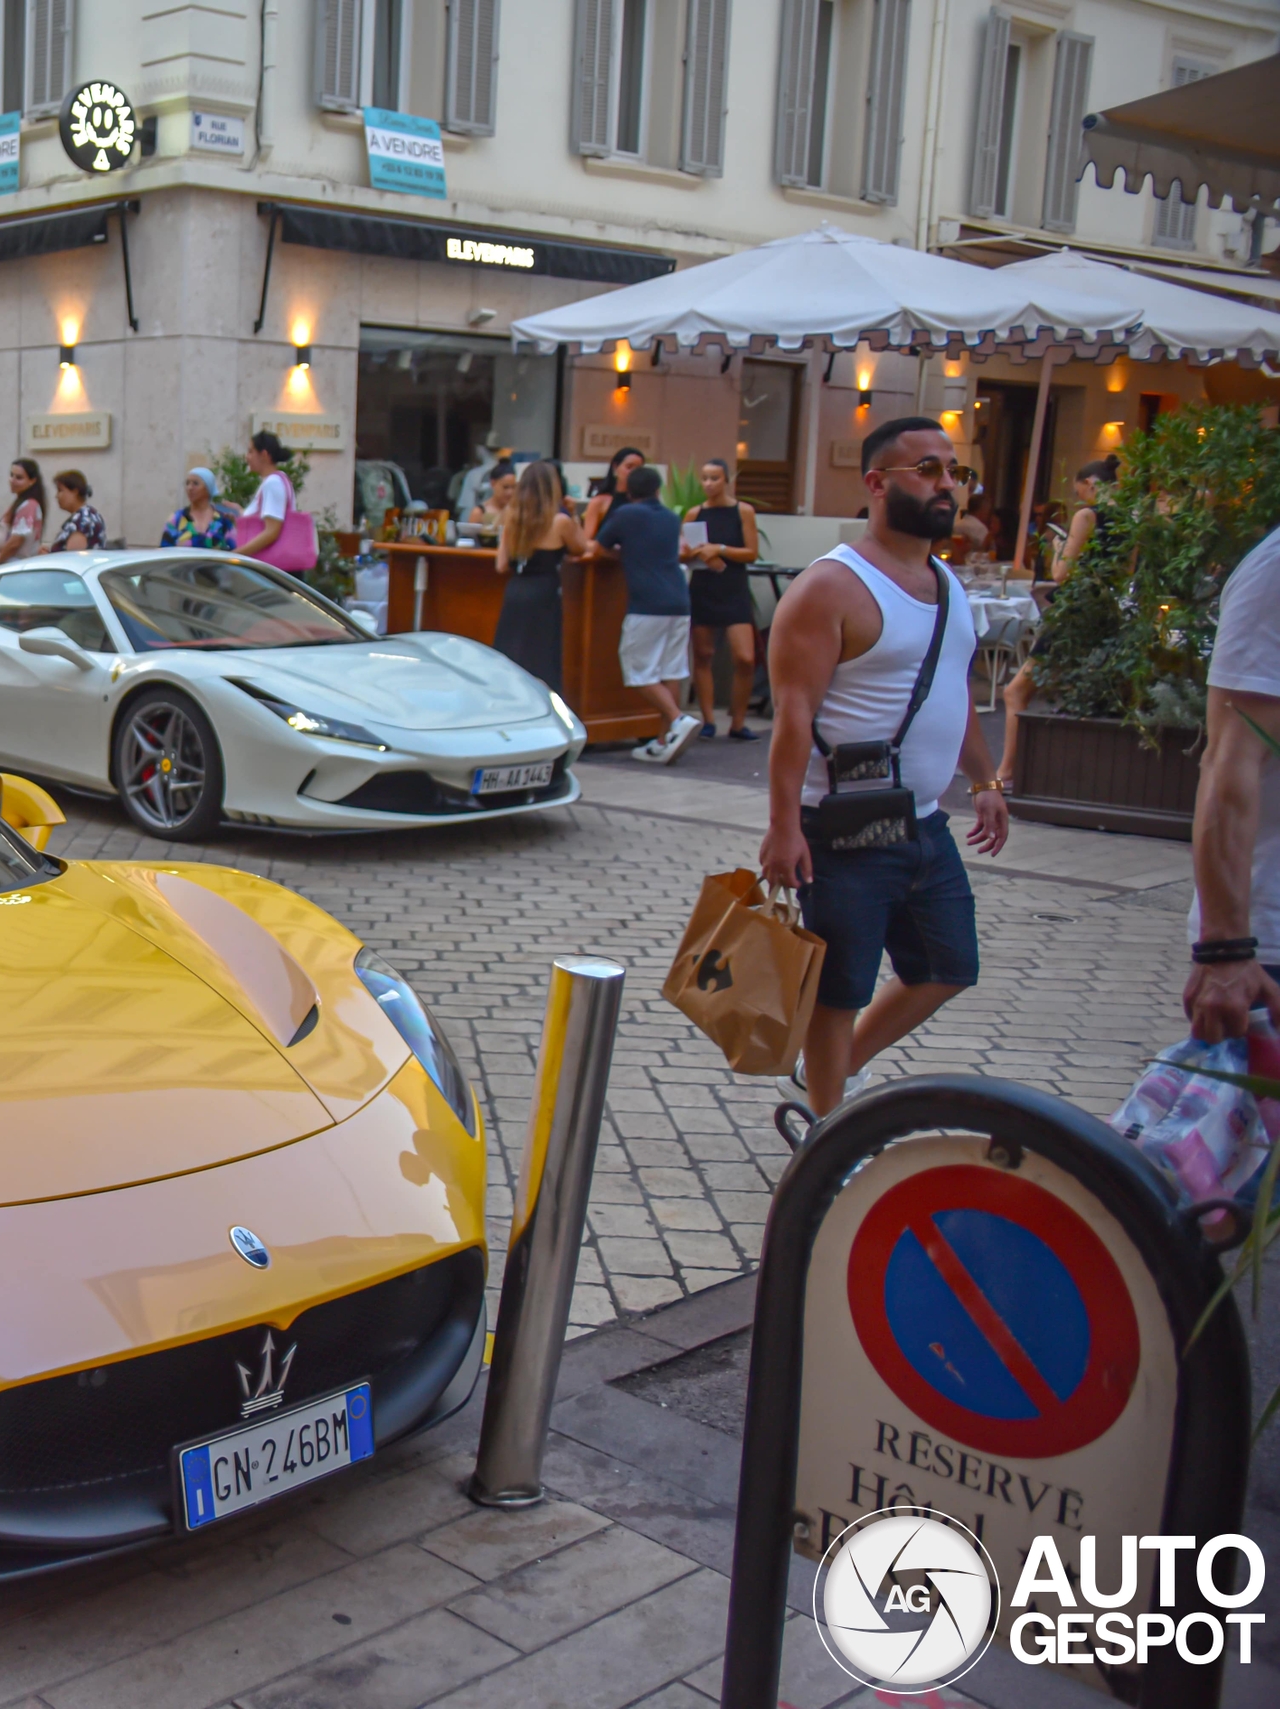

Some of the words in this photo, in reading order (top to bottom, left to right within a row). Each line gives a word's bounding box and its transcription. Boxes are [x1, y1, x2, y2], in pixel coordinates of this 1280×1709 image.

[211, 120, 227, 131] RUE
[199, 131, 239, 147] FLORIAN
[381, 135, 442, 162] VENDRE
